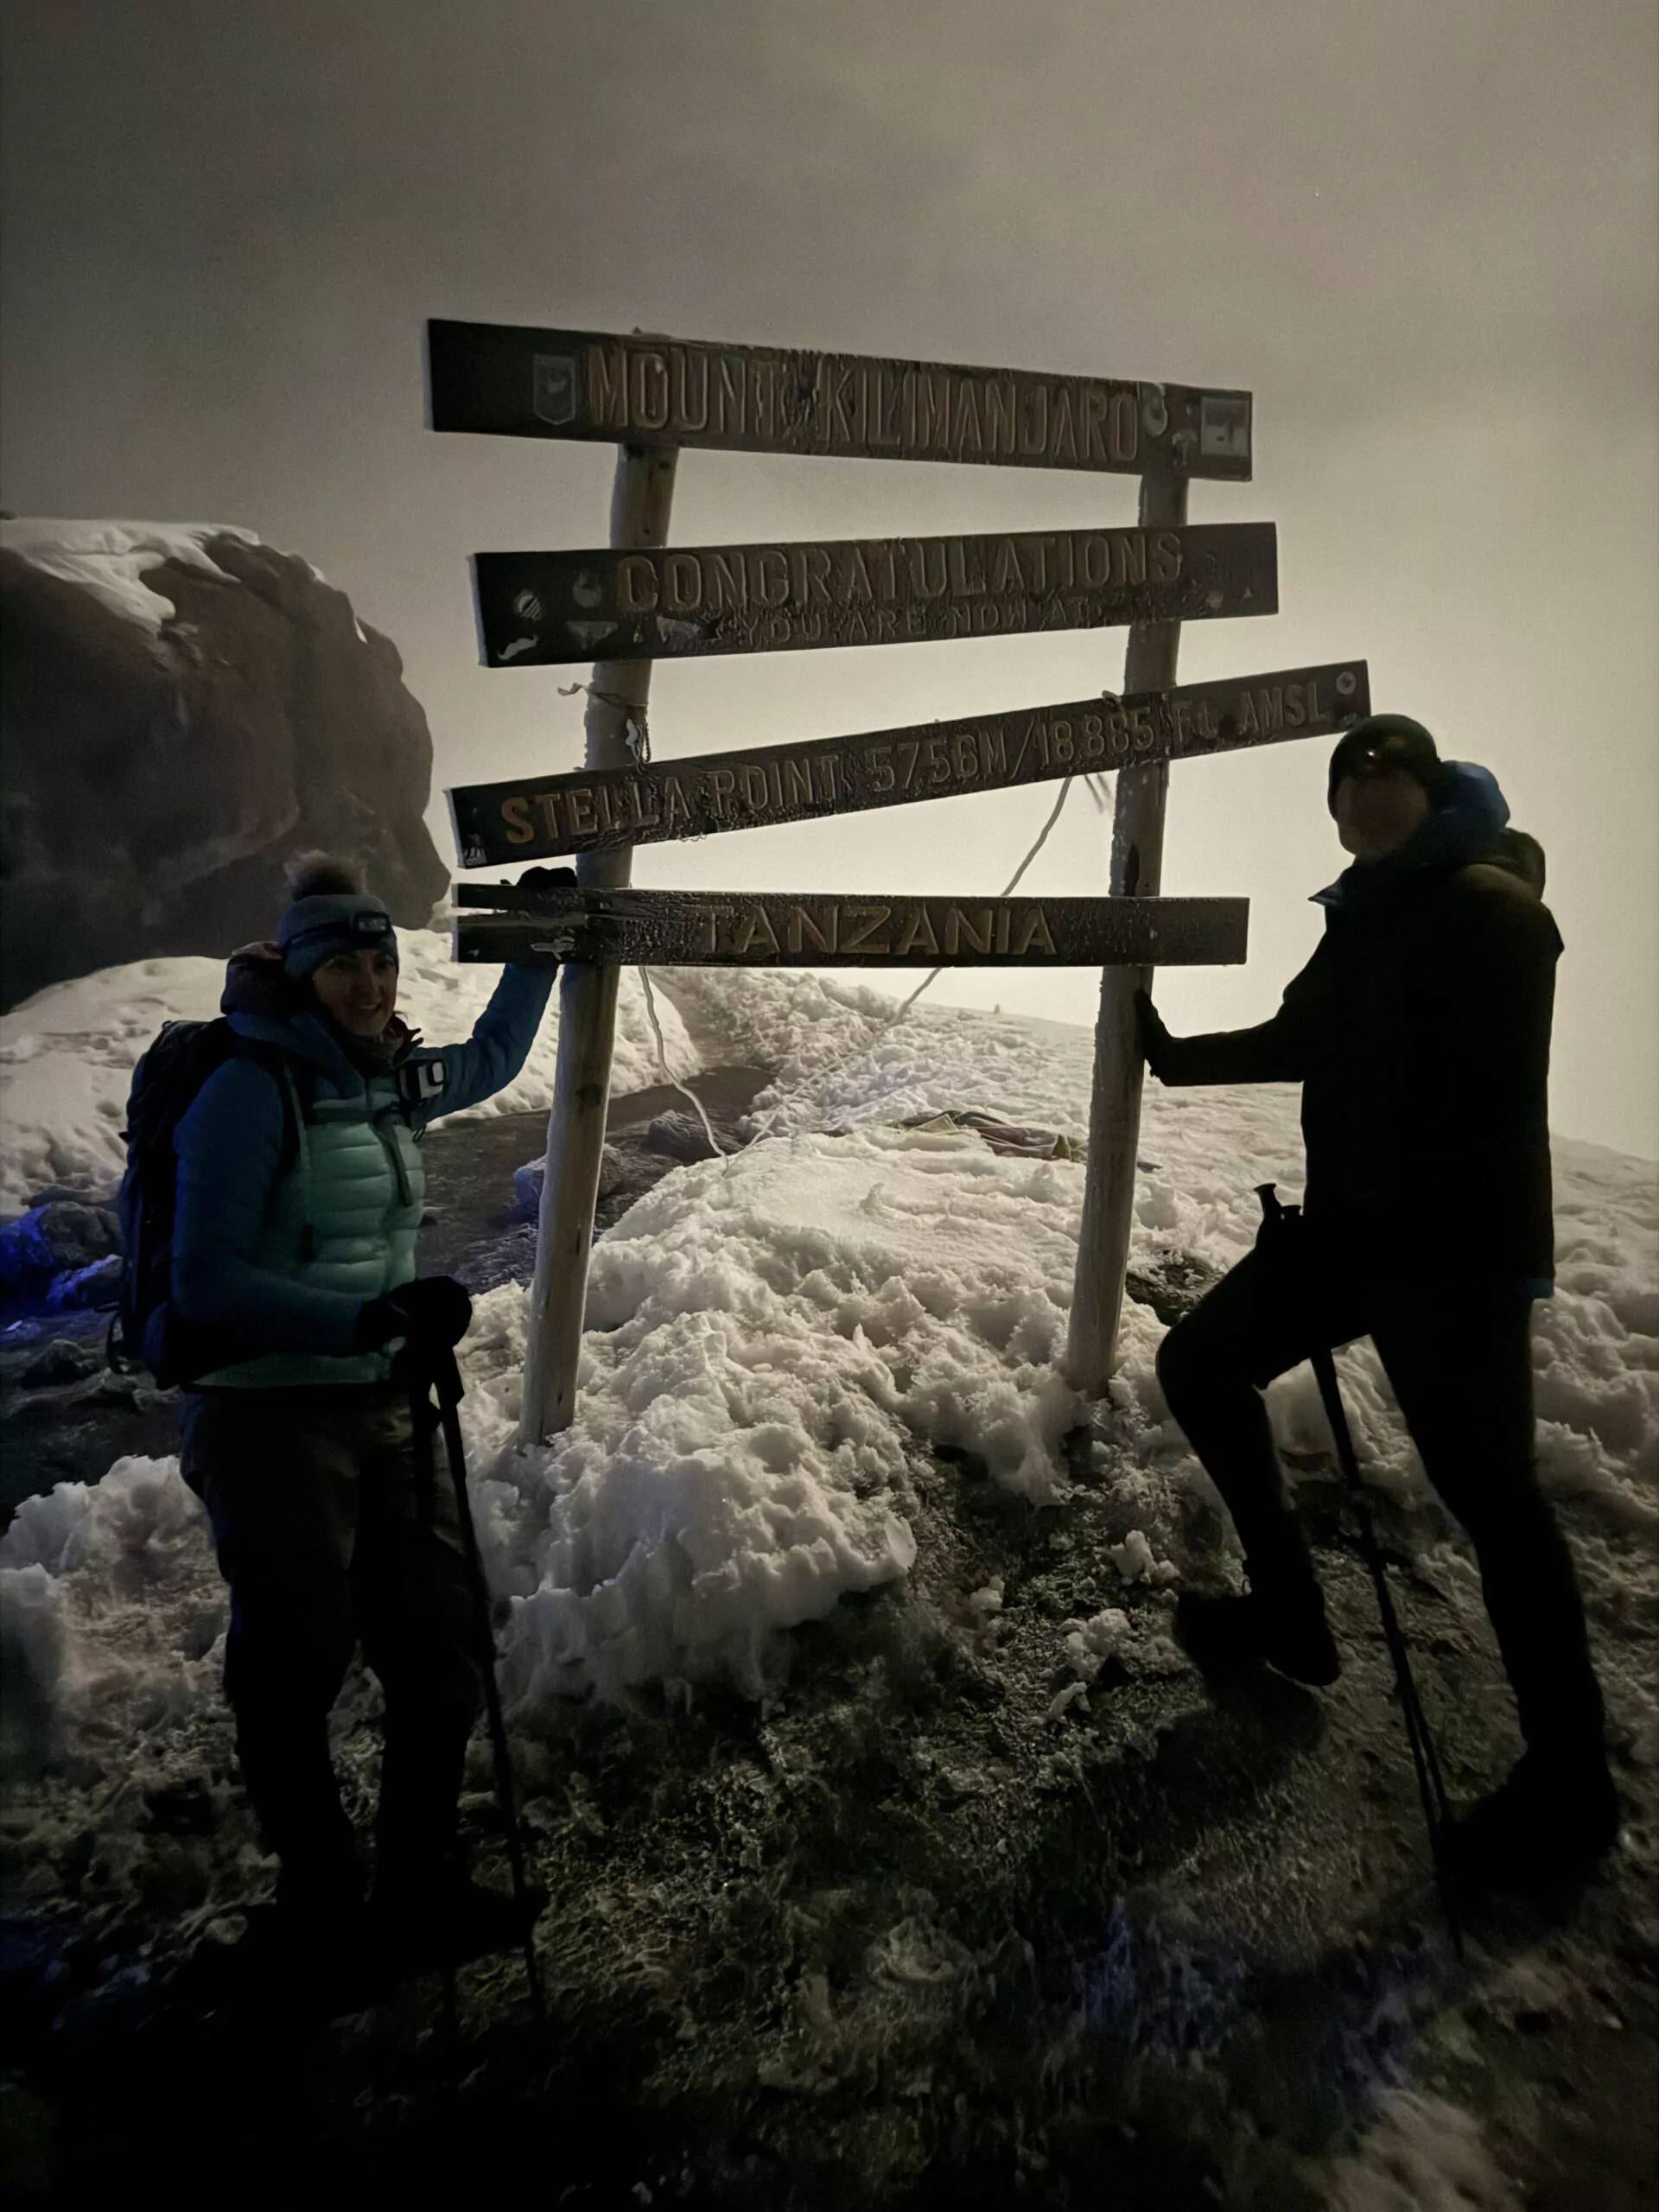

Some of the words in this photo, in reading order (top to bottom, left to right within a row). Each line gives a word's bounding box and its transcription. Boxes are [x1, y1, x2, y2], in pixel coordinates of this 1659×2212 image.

[588, 343, 782, 438] MOUNT
[817, 356, 1138, 462] KILIMANJARO
[617, 531, 1183, 613] CONGRATULATIONS
[741, 611, 823, 648] YOU
[848, 604, 926, 645] ARE
[948, 598, 1027, 638] NOW
[500, 775, 693, 845] STELLA
[707, 754, 842, 819] POINT
[1238, 680, 1329, 736] AMSL
[696, 903, 1058, 957] TANZANIA
